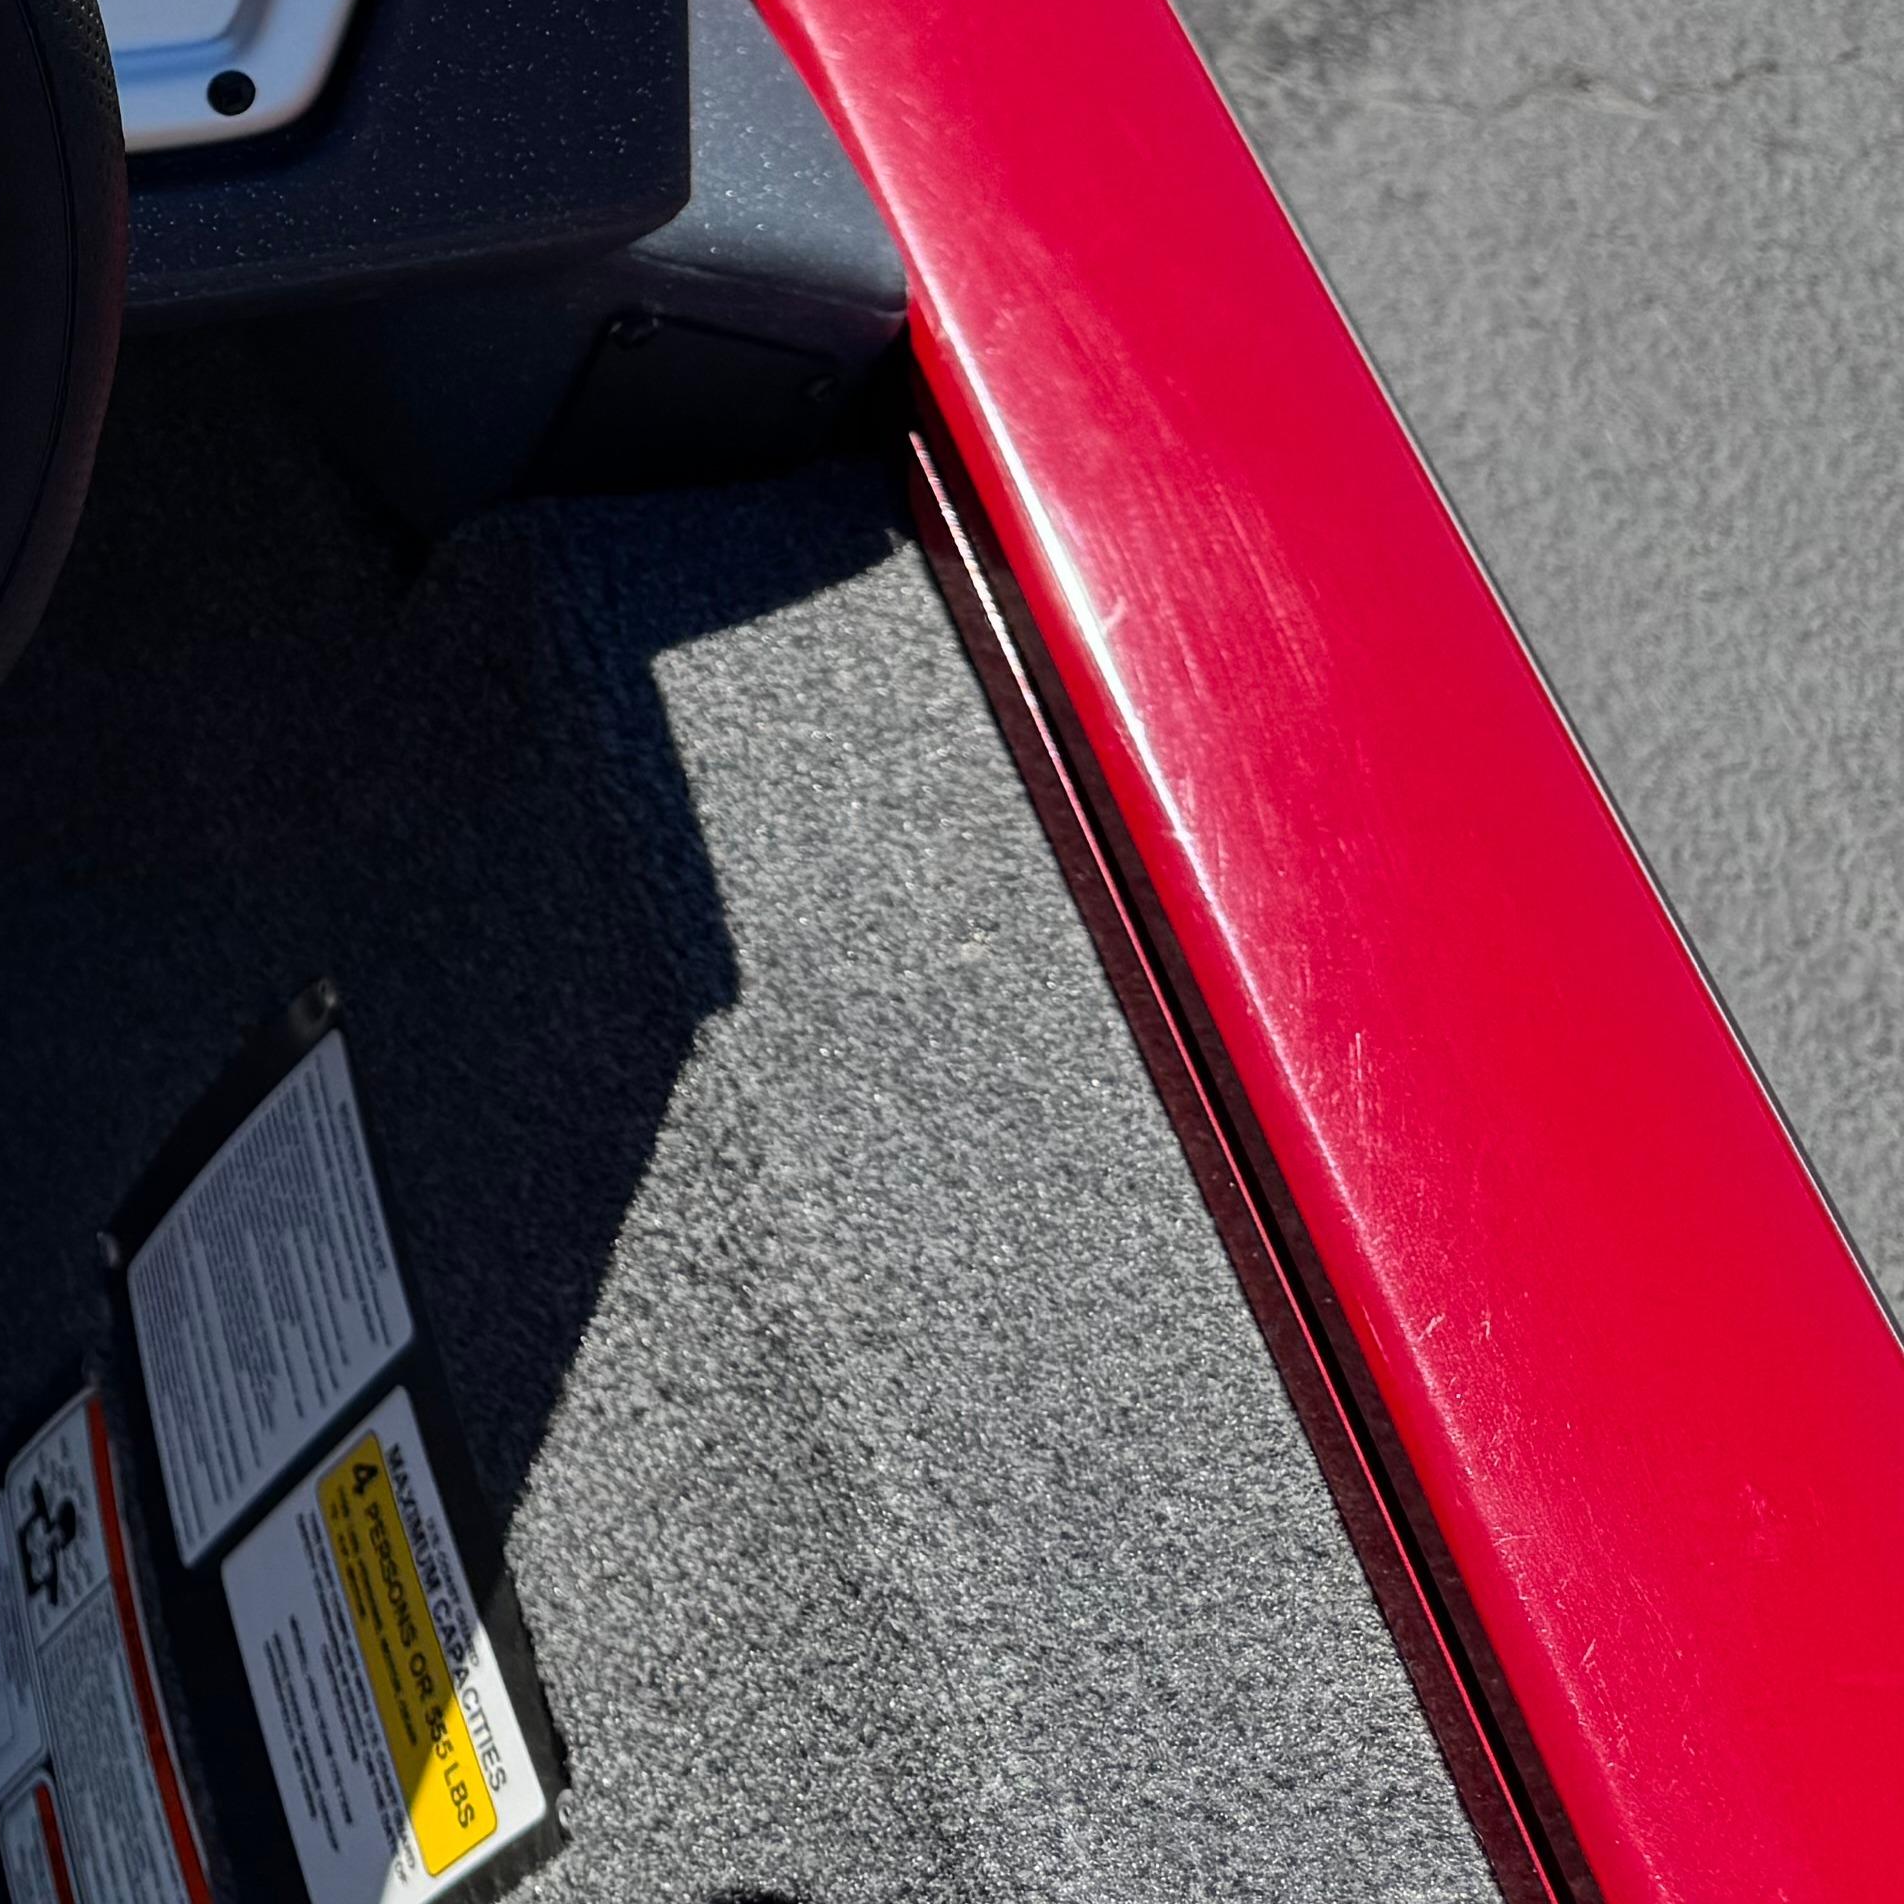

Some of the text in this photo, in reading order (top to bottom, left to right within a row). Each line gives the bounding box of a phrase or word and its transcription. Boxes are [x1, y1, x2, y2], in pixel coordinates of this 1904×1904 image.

[350, 1459, 379, 1498] 4
[362, 1499, 420, 1651] PERSONS
[385, 1443, 508, 1794] MAXIMUM CAPACITIES
[408, 1649, 435, 1705] OR
[444, 1762, 476, 1831] LBS
